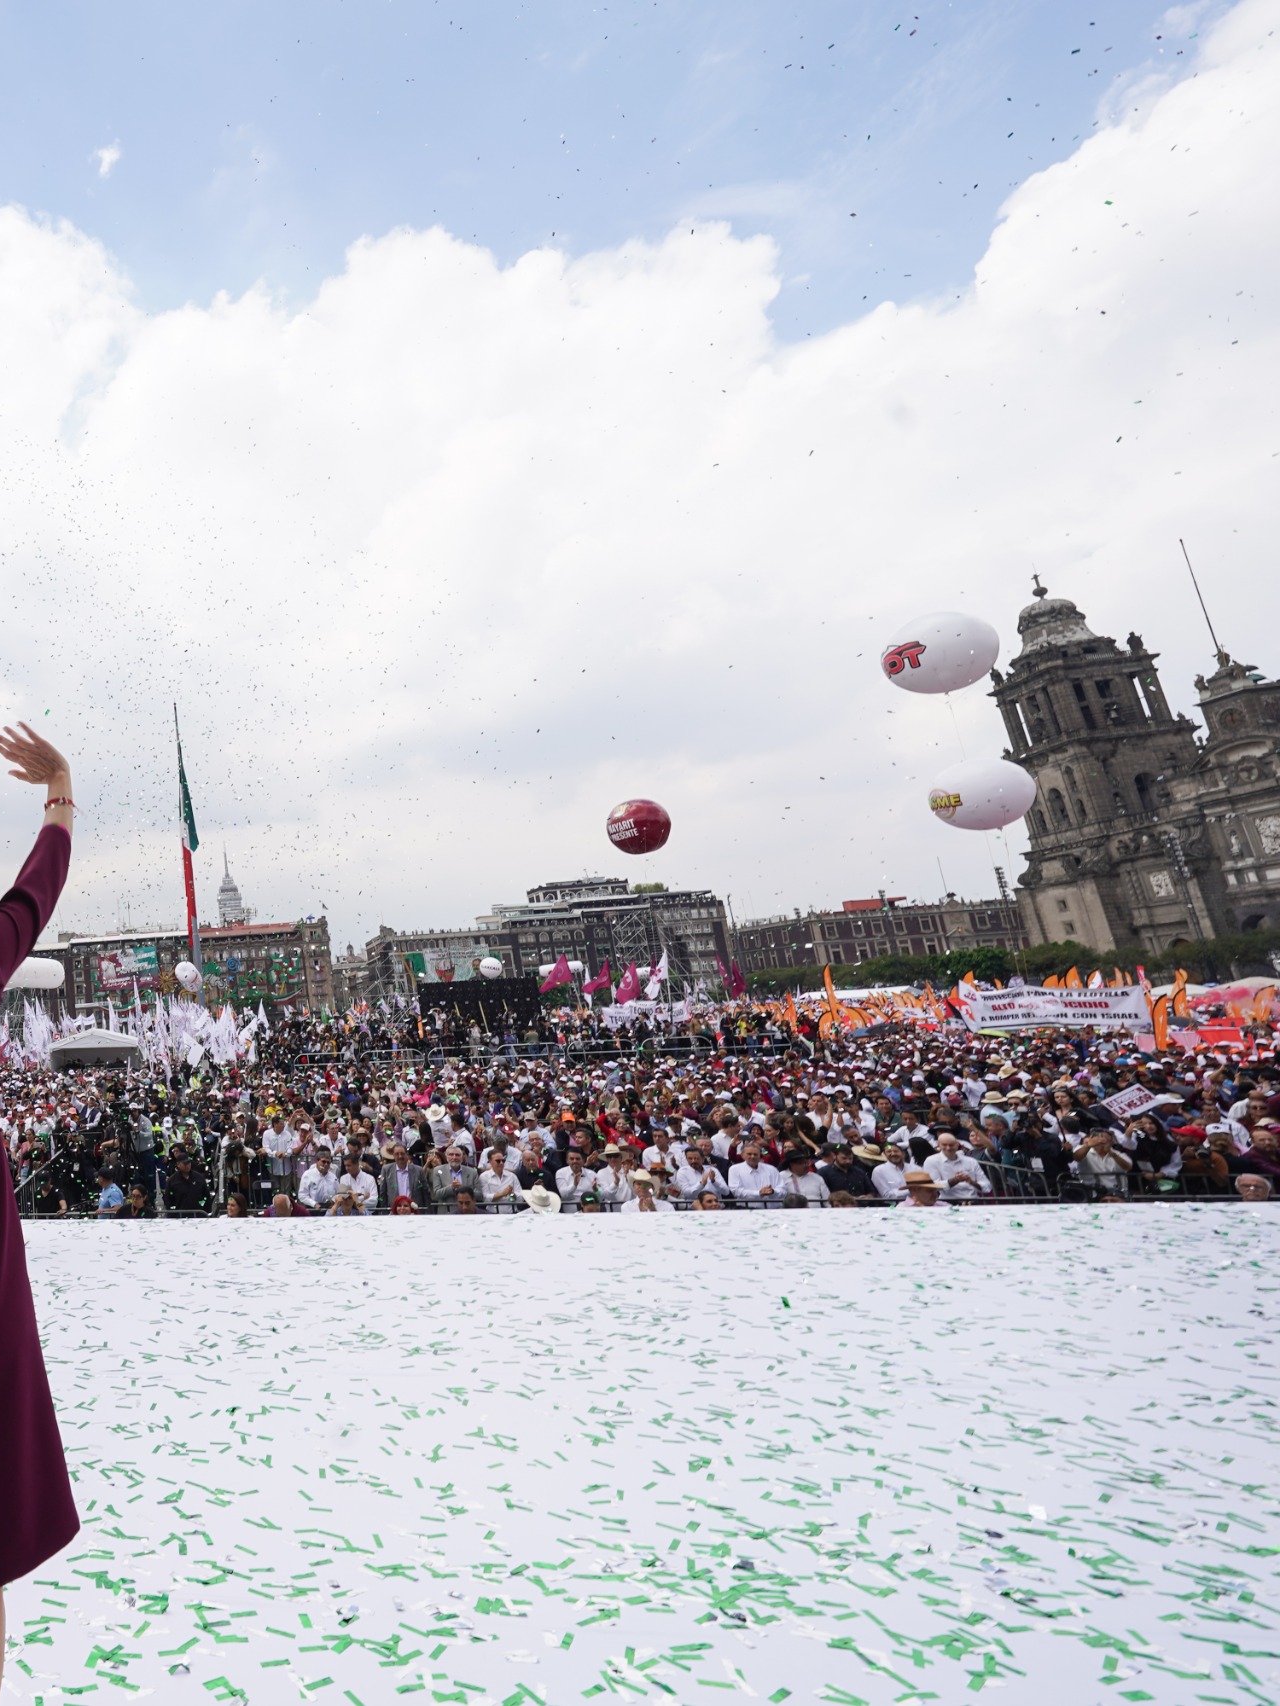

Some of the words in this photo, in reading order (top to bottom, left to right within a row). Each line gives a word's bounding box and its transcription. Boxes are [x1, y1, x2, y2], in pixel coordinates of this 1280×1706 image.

[883, 645, 927, 676] OT
[611, 828, 639, 841] PRESENTE
[991, 1002, 1016, 1011] ALTO
[1125, 1093, 1154, 1110] MEJOR
